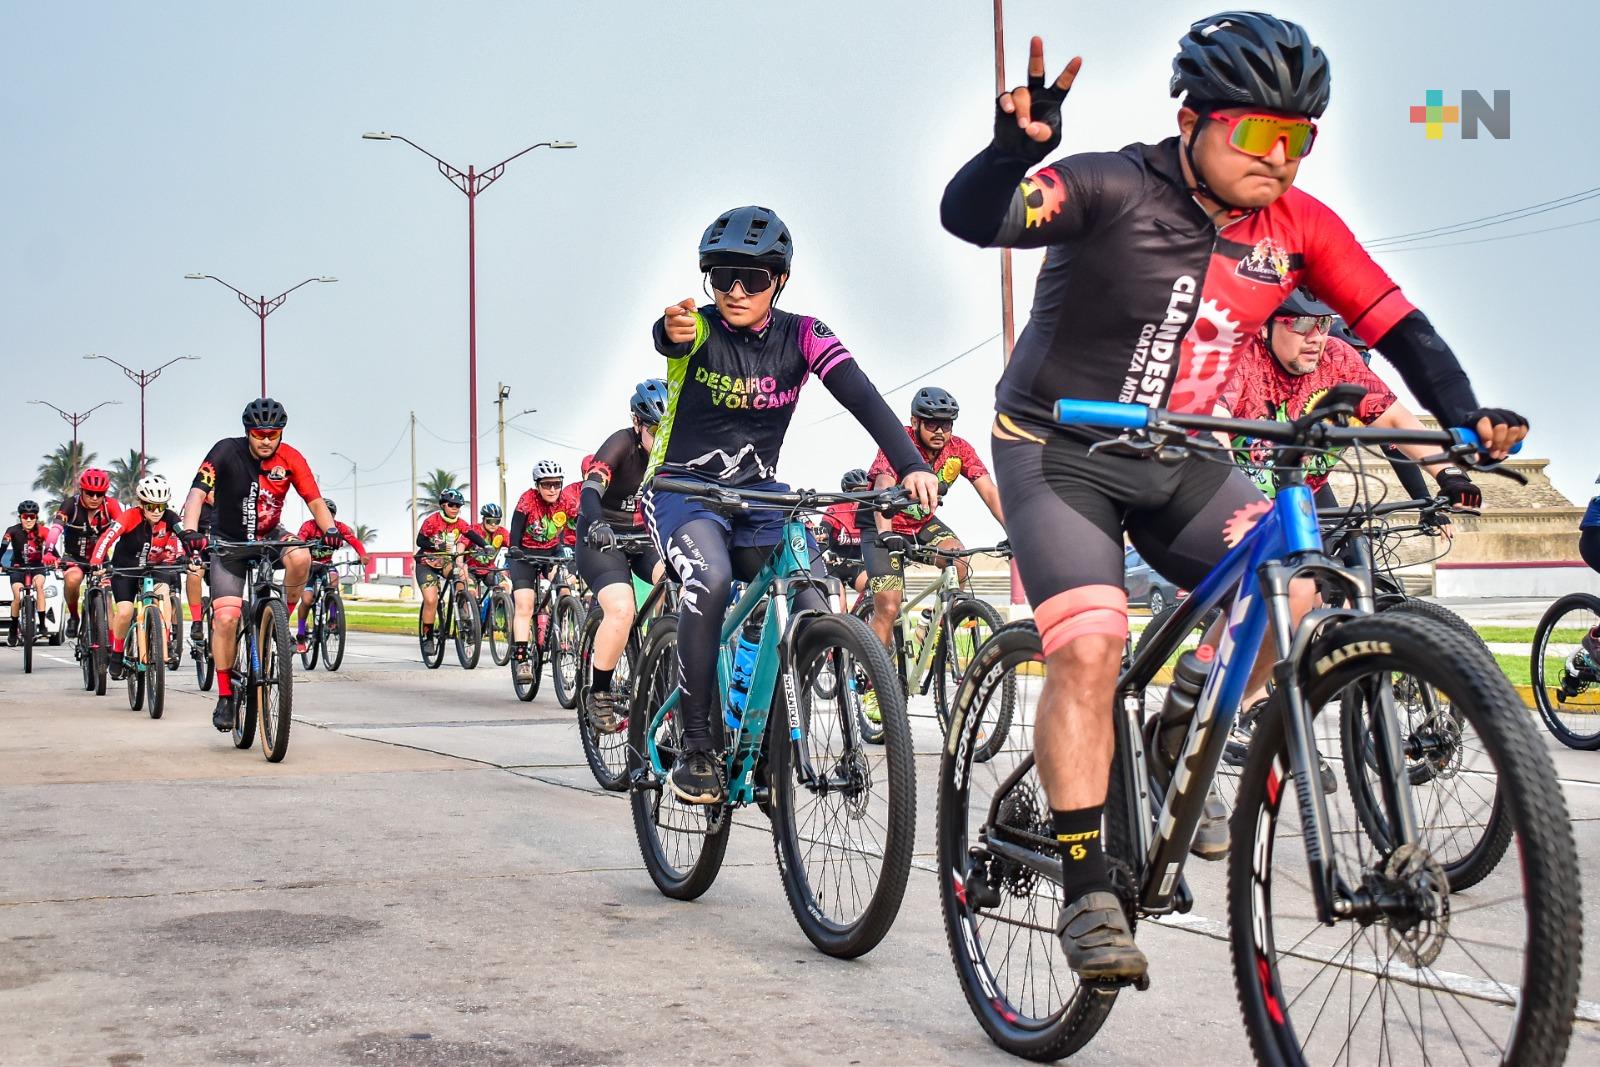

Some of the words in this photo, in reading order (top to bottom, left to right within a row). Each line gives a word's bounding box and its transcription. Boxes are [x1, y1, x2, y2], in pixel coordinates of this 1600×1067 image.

[1127, 323, 1157, 372] COATZA
[1136, 275, 1197, 409] CLANDEST
[1118, 376, 1139, 404] MTB
[681, 533, 696, 549] TEAM
[1315, 640, 1393, 677] MAXXIS
[785, 690, 800, 727] SUNTOUR
[953, 660, 1005, 792] BONTRAGER
[1149, 573, 1253, 864] TREK
